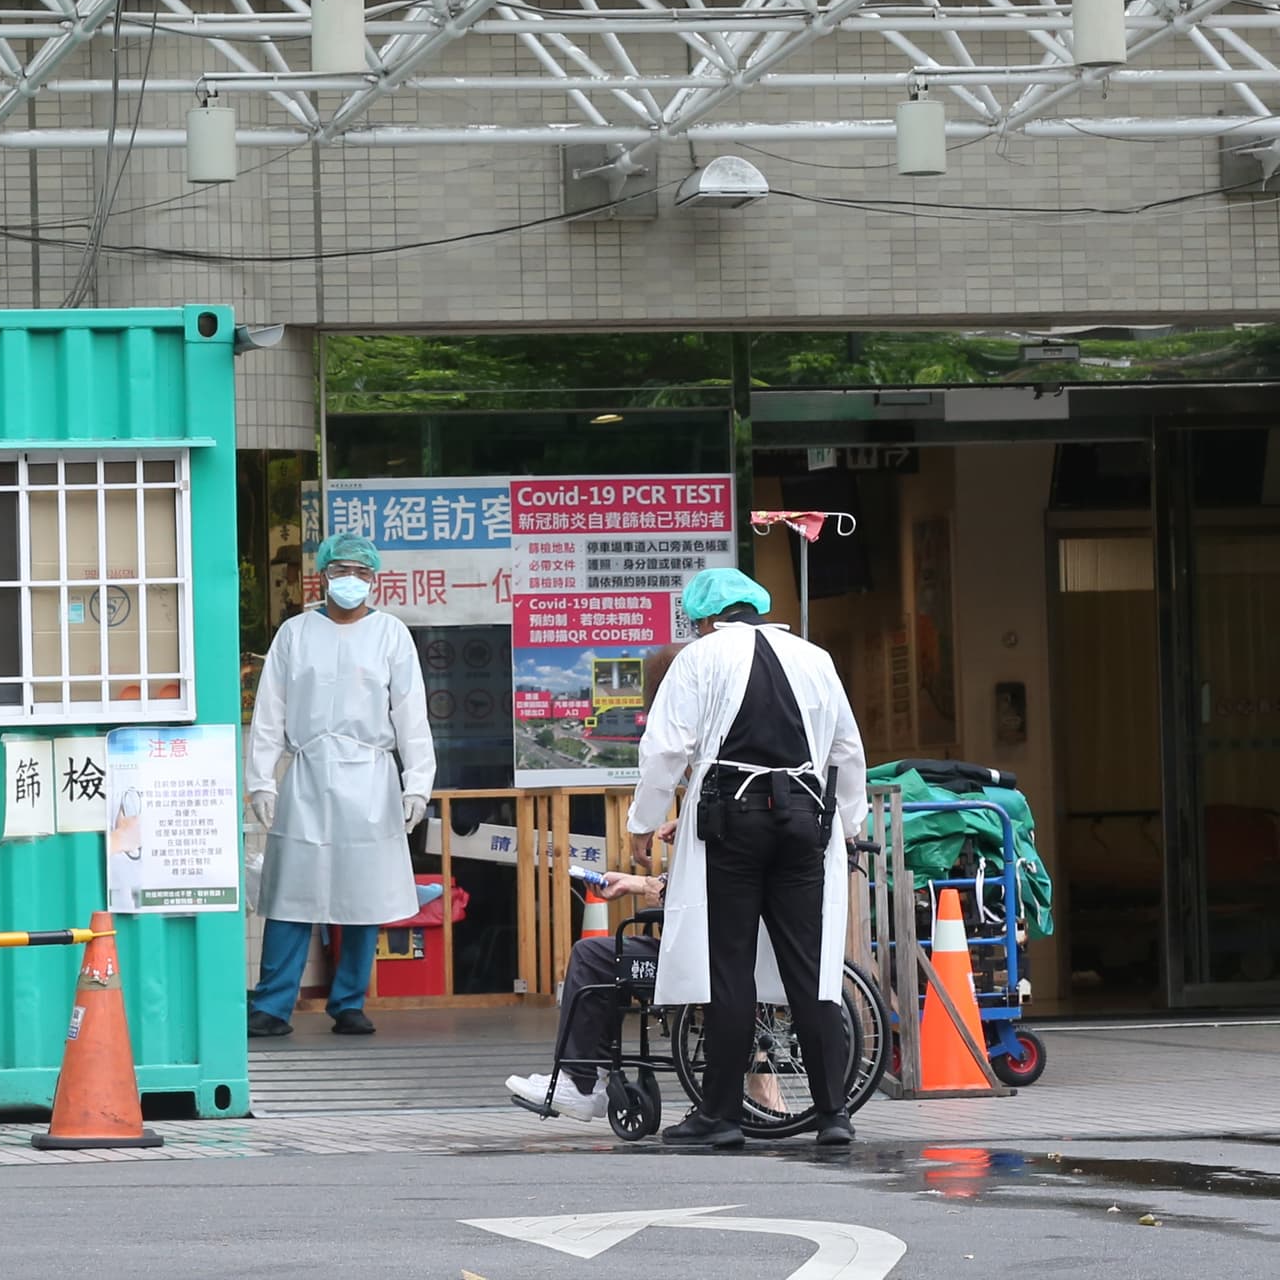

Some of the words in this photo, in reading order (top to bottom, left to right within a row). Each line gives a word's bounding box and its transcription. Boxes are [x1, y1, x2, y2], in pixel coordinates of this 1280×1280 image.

[517, 486, 615, 507] Covid-19
[622, 485, 667, 504] PCR
[671, 484, 725, 504] TEST
[518, 511, 725, 530] 新冠肺炎自費篩檢已預約者
[148, 738, 188, 758] 注意
